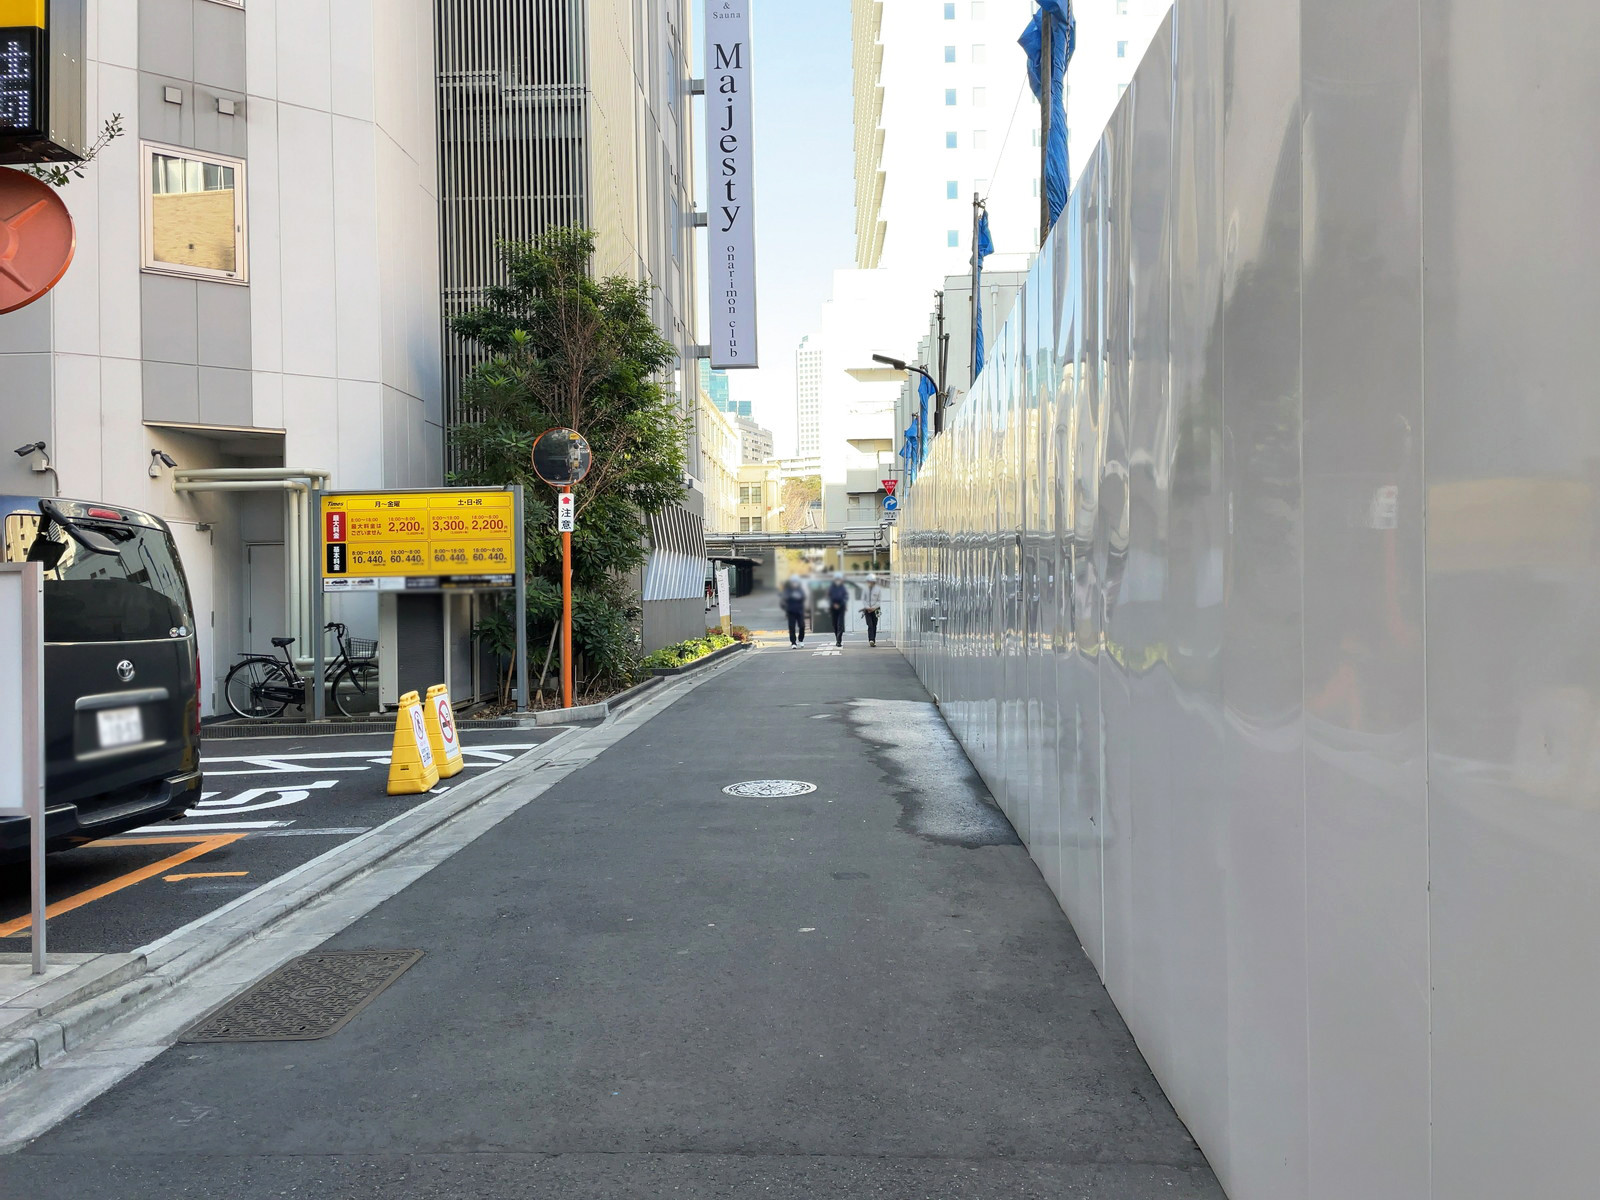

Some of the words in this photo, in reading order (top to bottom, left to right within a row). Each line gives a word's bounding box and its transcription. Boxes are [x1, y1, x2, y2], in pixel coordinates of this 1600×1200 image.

[713, 11, 741, 19] Sauna
[723, 2, 730, 10] &
[713, 42, 743, 232] Majesty
[726, 245, 737, 314] onarimon
[729, 320, 738, 357] club
[561, 508, 571, 530] 注意
